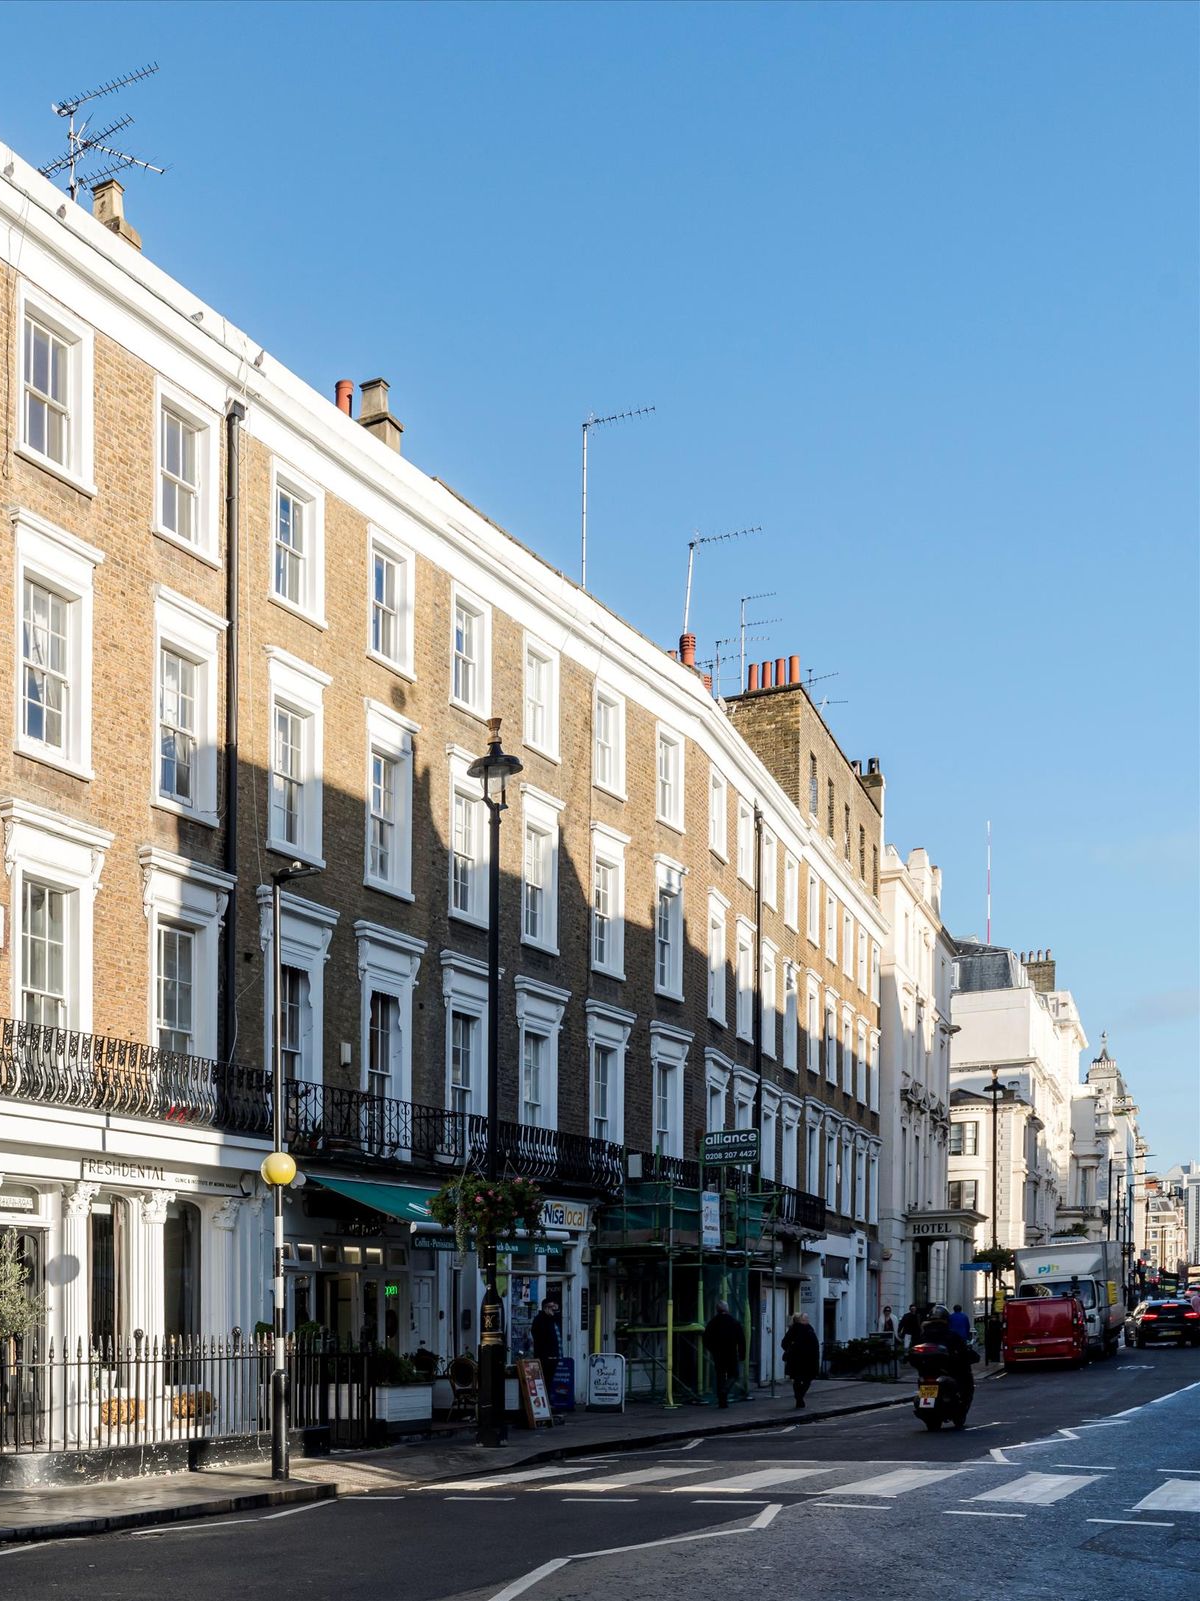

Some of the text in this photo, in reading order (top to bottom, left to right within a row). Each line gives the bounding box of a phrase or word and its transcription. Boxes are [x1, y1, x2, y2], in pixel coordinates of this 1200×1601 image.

[705, 1133, 757, 1145] alliance
[705, 1152, 723, 1160] 0208
[724, 1151, 738, 1159] 207
[81, 1157, 166, 1182] FRESHDENTAL
[912, 1223, 952, 1234] HOTEL
[1038, 1264, 1060, 1275] pjh
